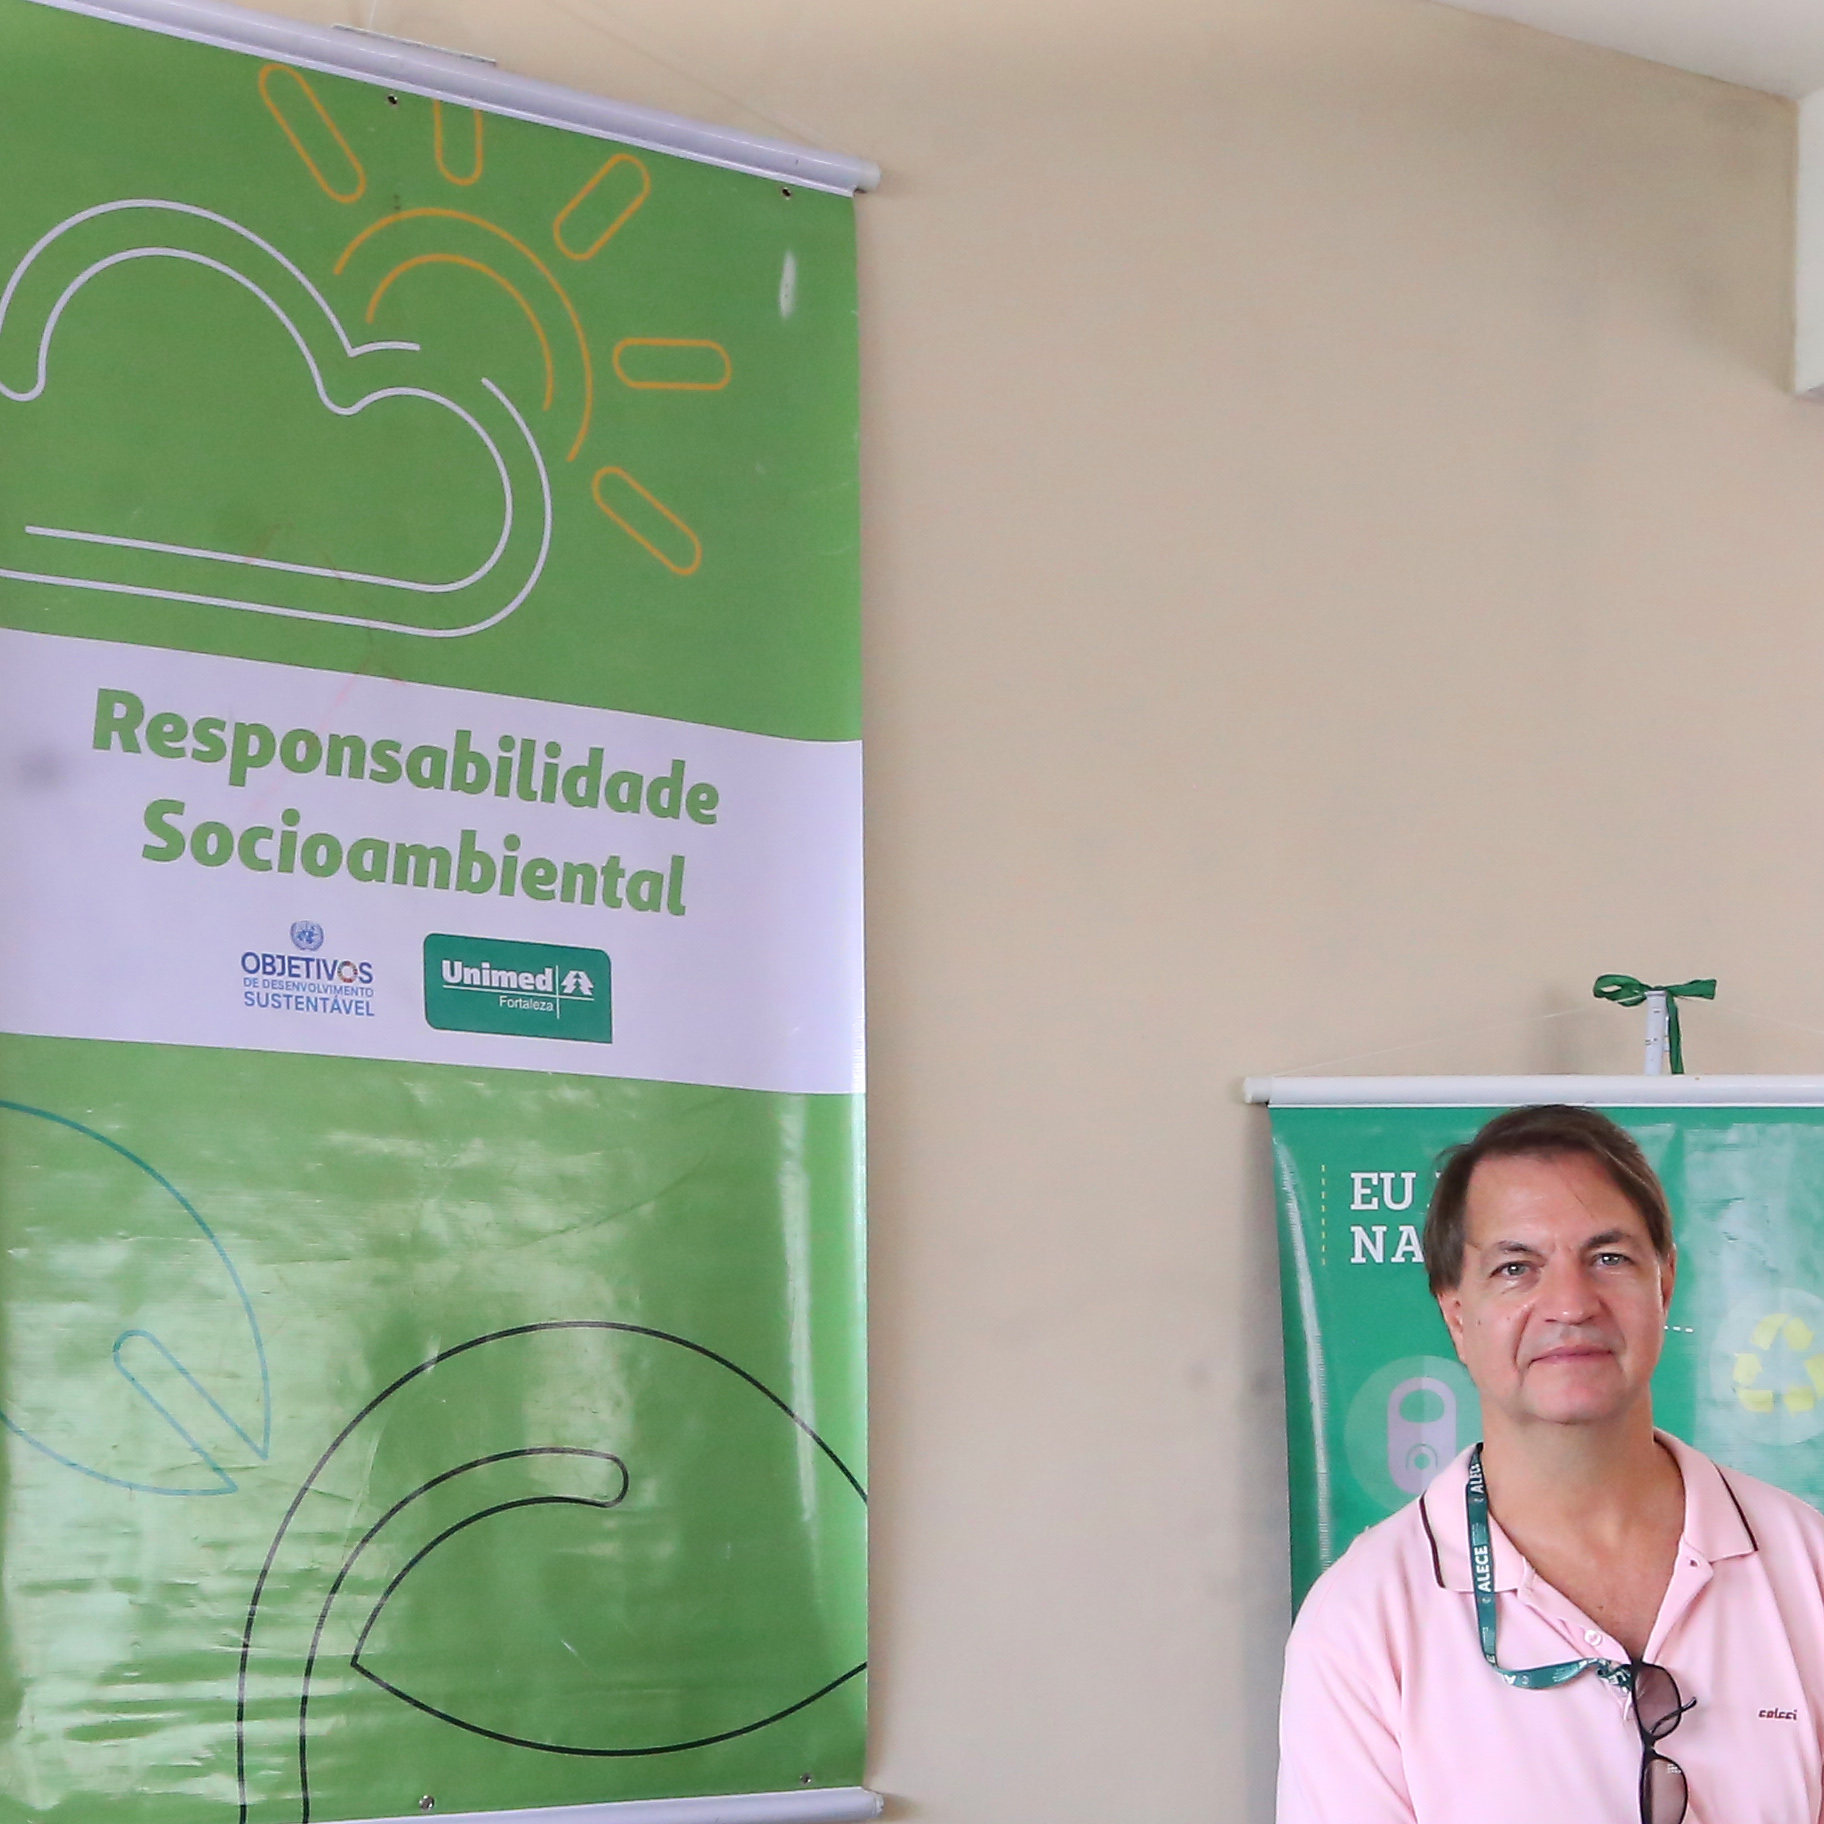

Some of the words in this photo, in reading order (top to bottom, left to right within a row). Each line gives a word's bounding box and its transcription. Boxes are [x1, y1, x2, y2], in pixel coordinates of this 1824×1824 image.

[92, 687, 720, 826] Responsabilidade
[141, 798, 687, 917] Socioambiental
[241, 951, 374, 984] OBJETIVOS
[442, 959, 553, 992] Unimed
[243, 977, 259, 989] DE
[262, 977, 374, 998] DESENVOLVIMENTO
[499, 995, 554, 1012] Fortaleza
[244, 992, 375, 1017] SUSTENTÁVEL
[1350, 1171, 1417, 1211] EU
[1476, 1545, 1491, 1593] ALECE
